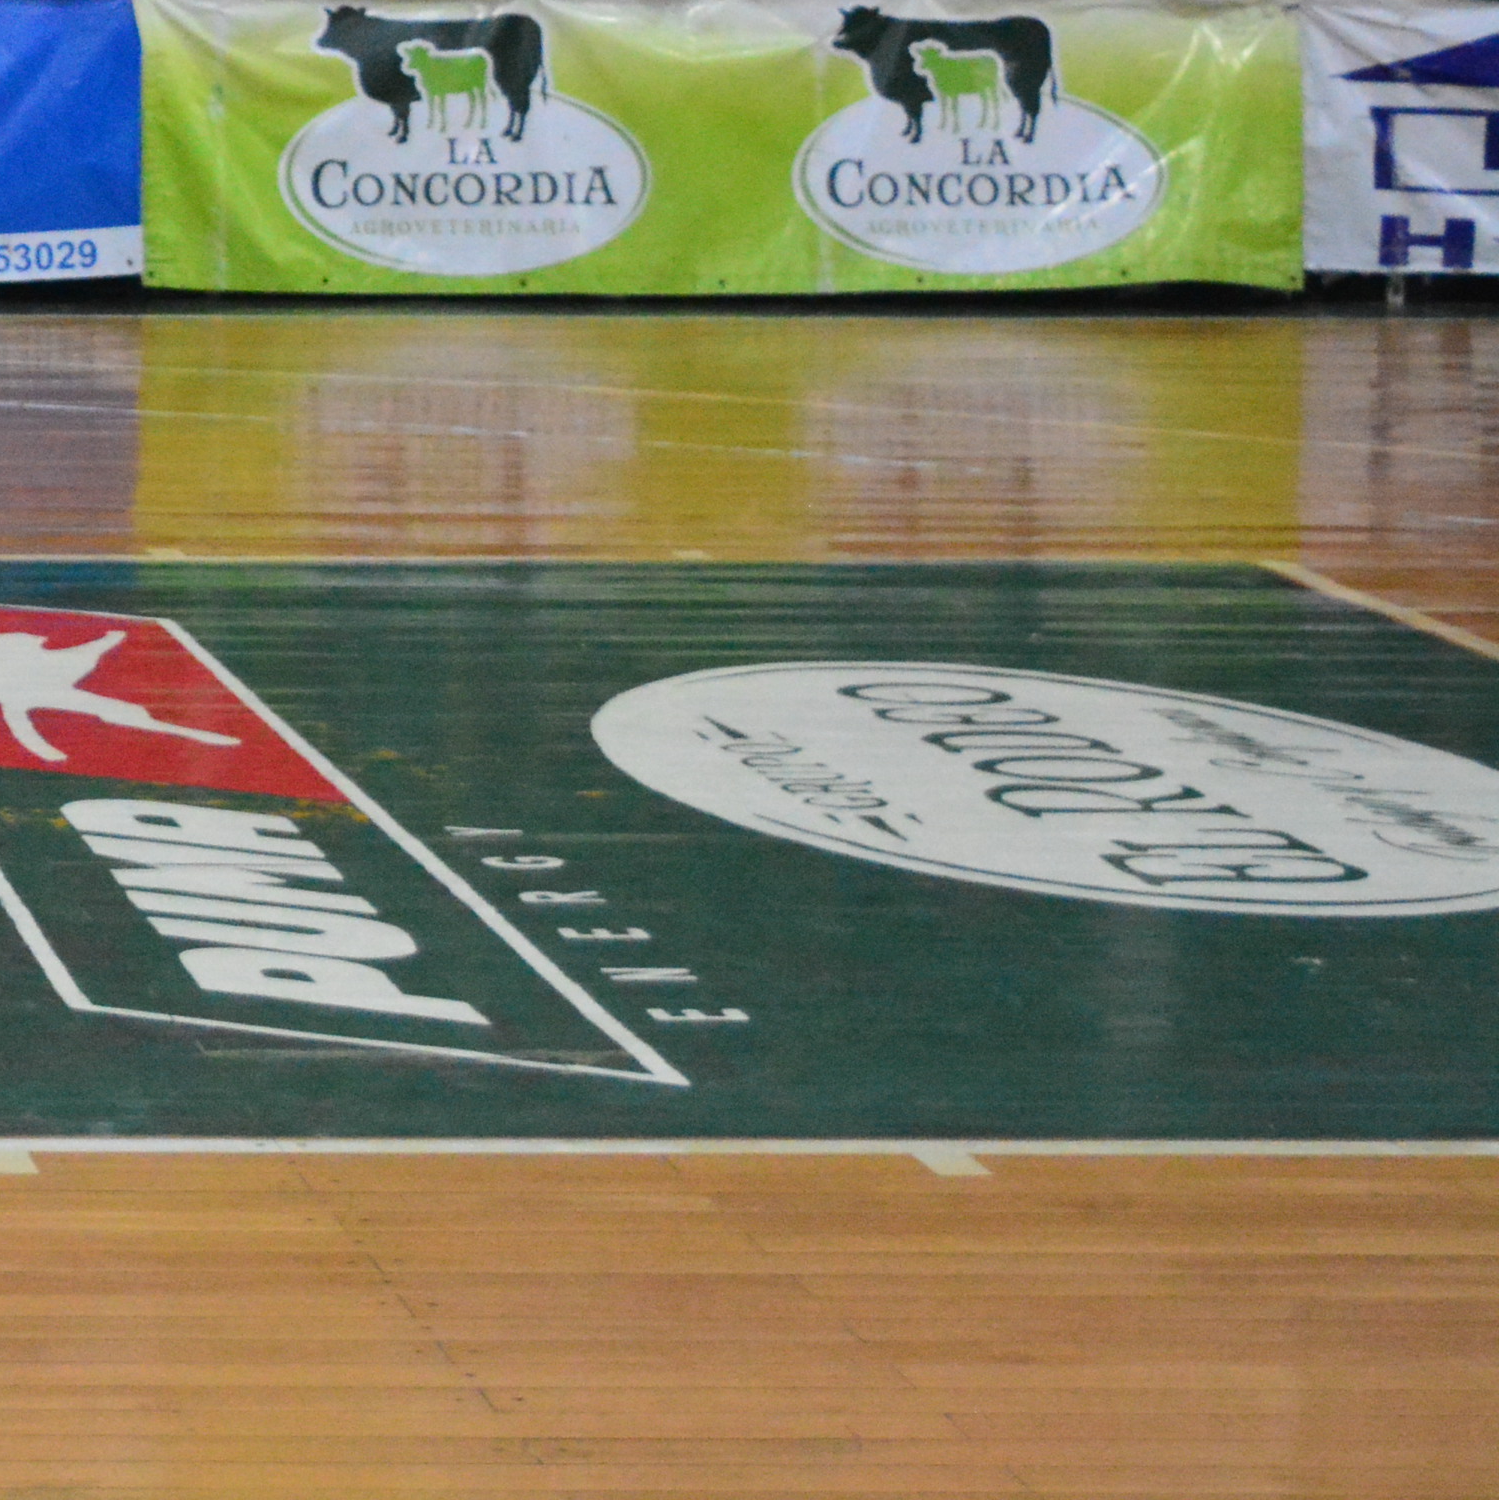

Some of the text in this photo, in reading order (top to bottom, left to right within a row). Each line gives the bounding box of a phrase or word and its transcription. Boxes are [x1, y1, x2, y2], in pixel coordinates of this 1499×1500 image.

[448, 138, 498, 165] LA
[960, 137, 1010, 165] LA
[311, 159, 618, 209] CONCORDIA
[827, 158, 1136, 208] CONCORDIA
[59, 799, 491, 1026] PUMA
[443, 825, 751, 1023] ENERGY
